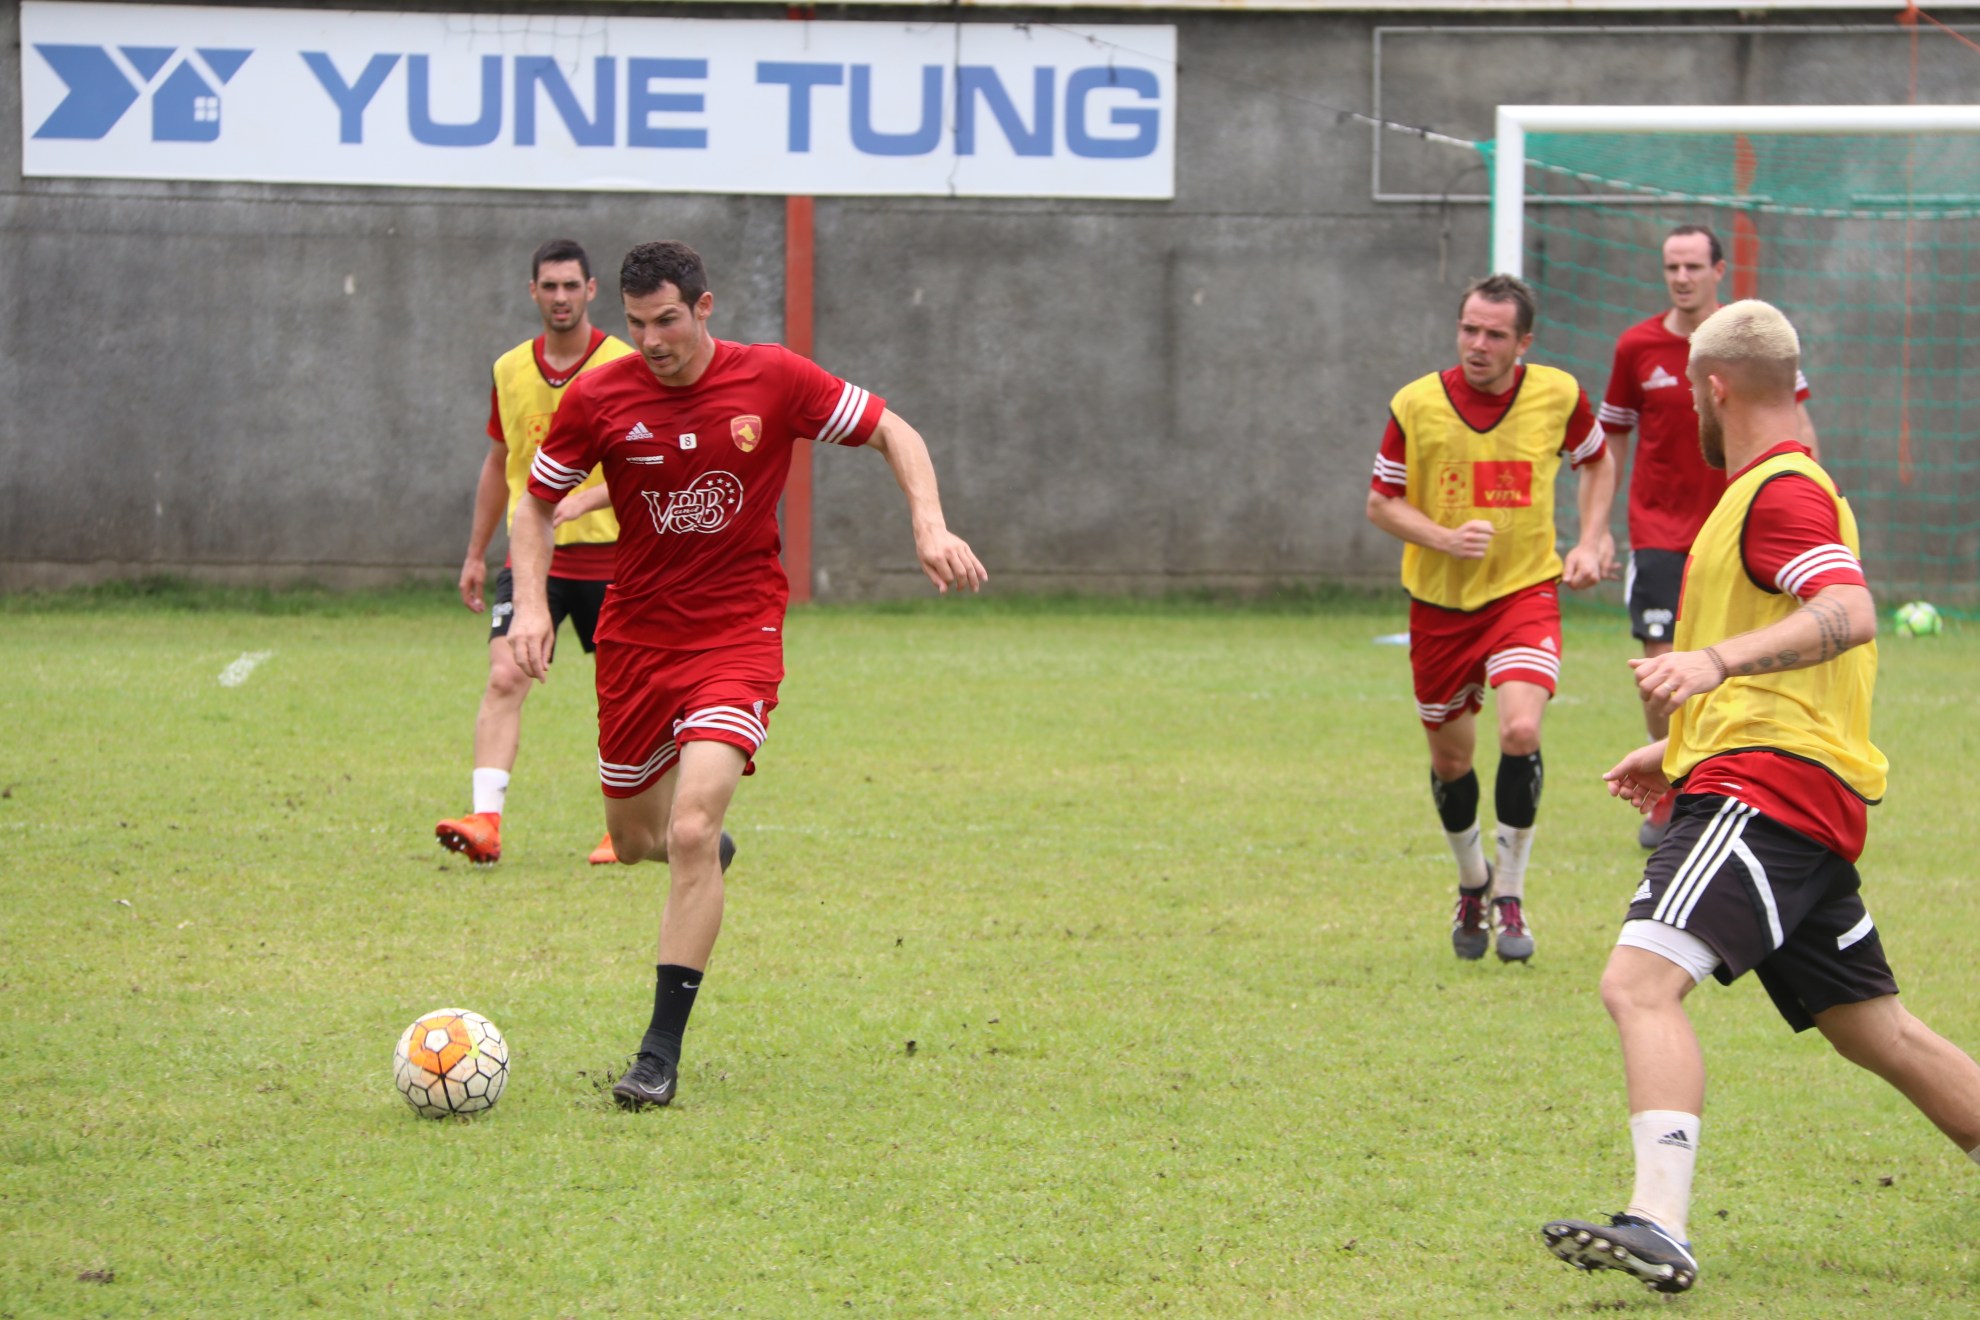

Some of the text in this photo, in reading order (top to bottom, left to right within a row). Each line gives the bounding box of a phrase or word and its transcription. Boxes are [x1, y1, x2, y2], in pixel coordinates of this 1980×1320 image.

[299, 50, 1162, 160] YUNE TUNG
[684, 436, 692, 447] 8
